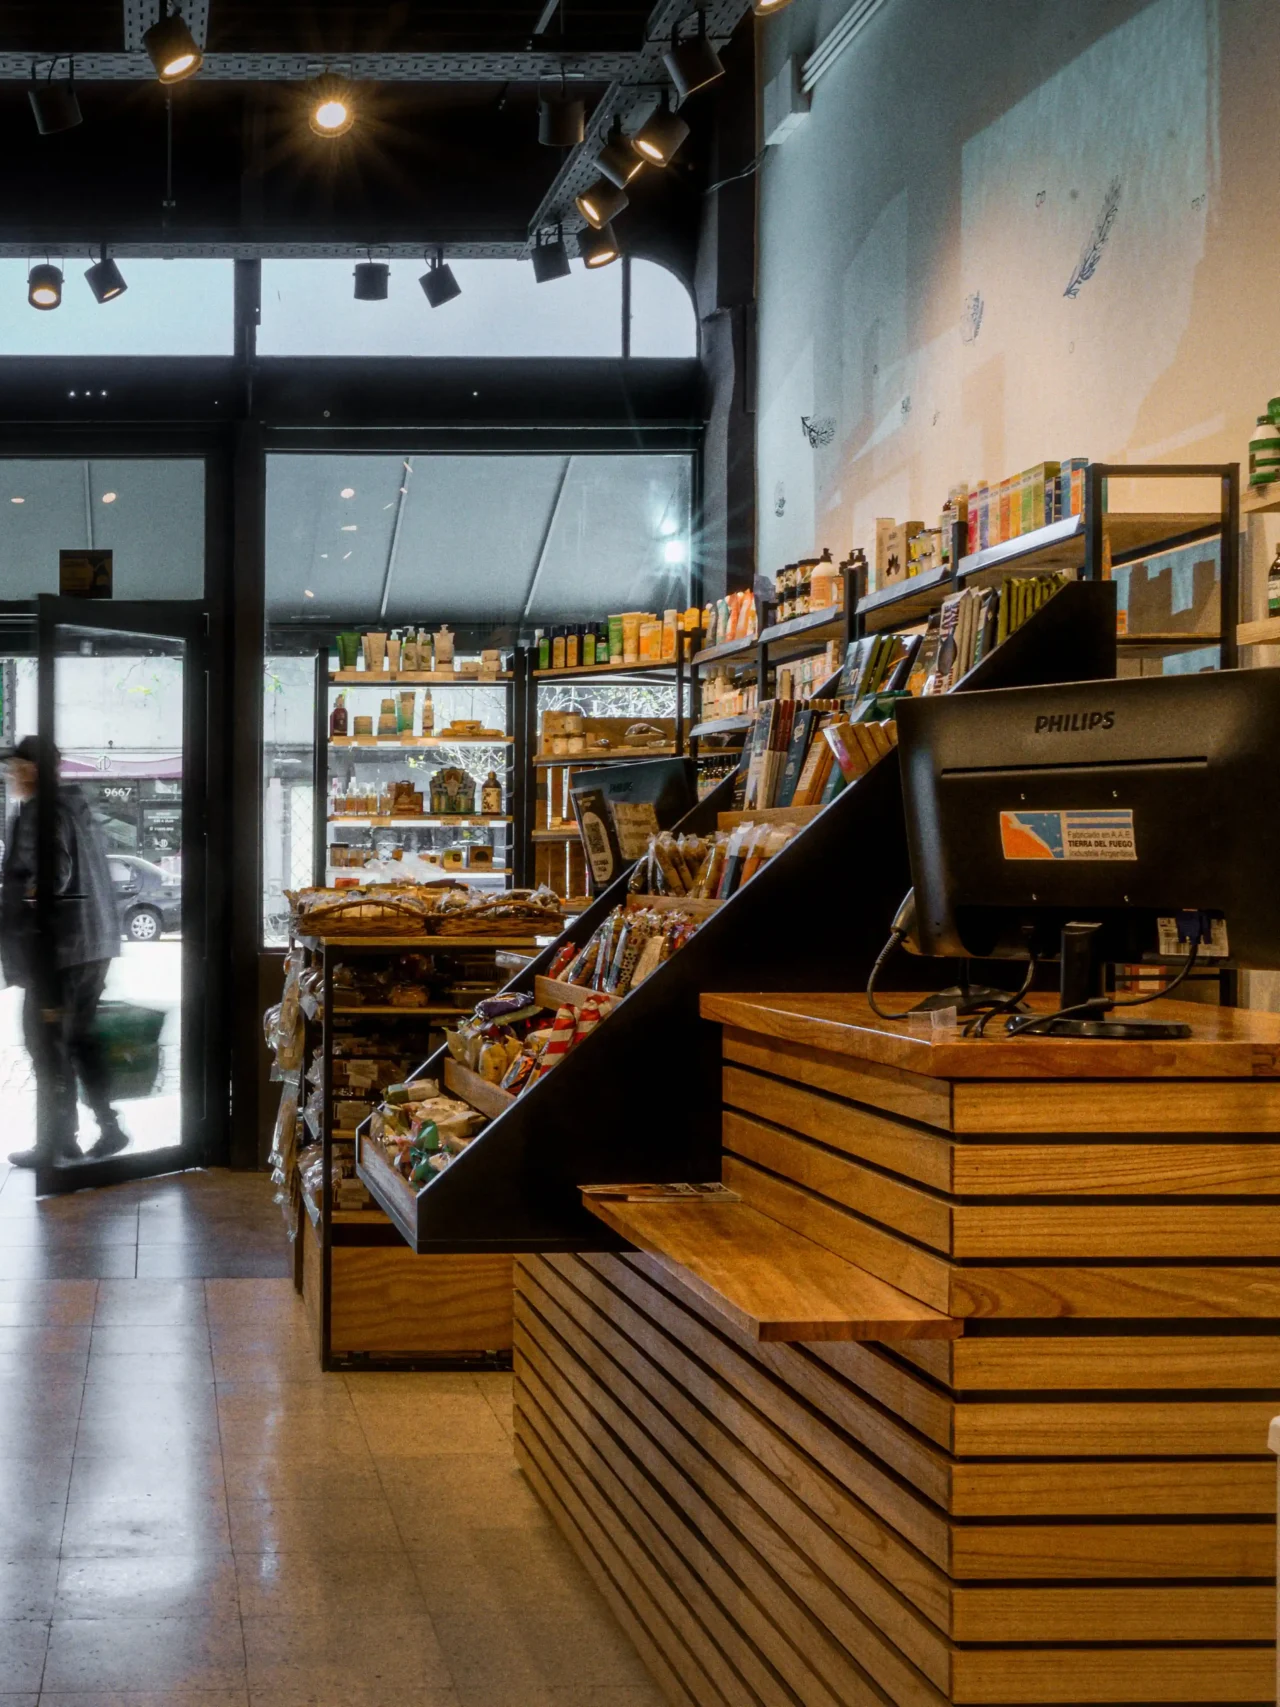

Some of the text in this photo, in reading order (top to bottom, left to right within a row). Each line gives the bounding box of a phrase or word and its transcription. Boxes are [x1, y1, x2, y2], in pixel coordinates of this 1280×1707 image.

[1035, 711, 1115, 733] PHILIPS
[104, 787, 132, 797] 9667
[1067, 830, 1100, 838] Fabricado
[1067, 840, 1133, 848] TIERRA DEL FUEGO
[1069, 849, 1134, 858] Industria Argentina
